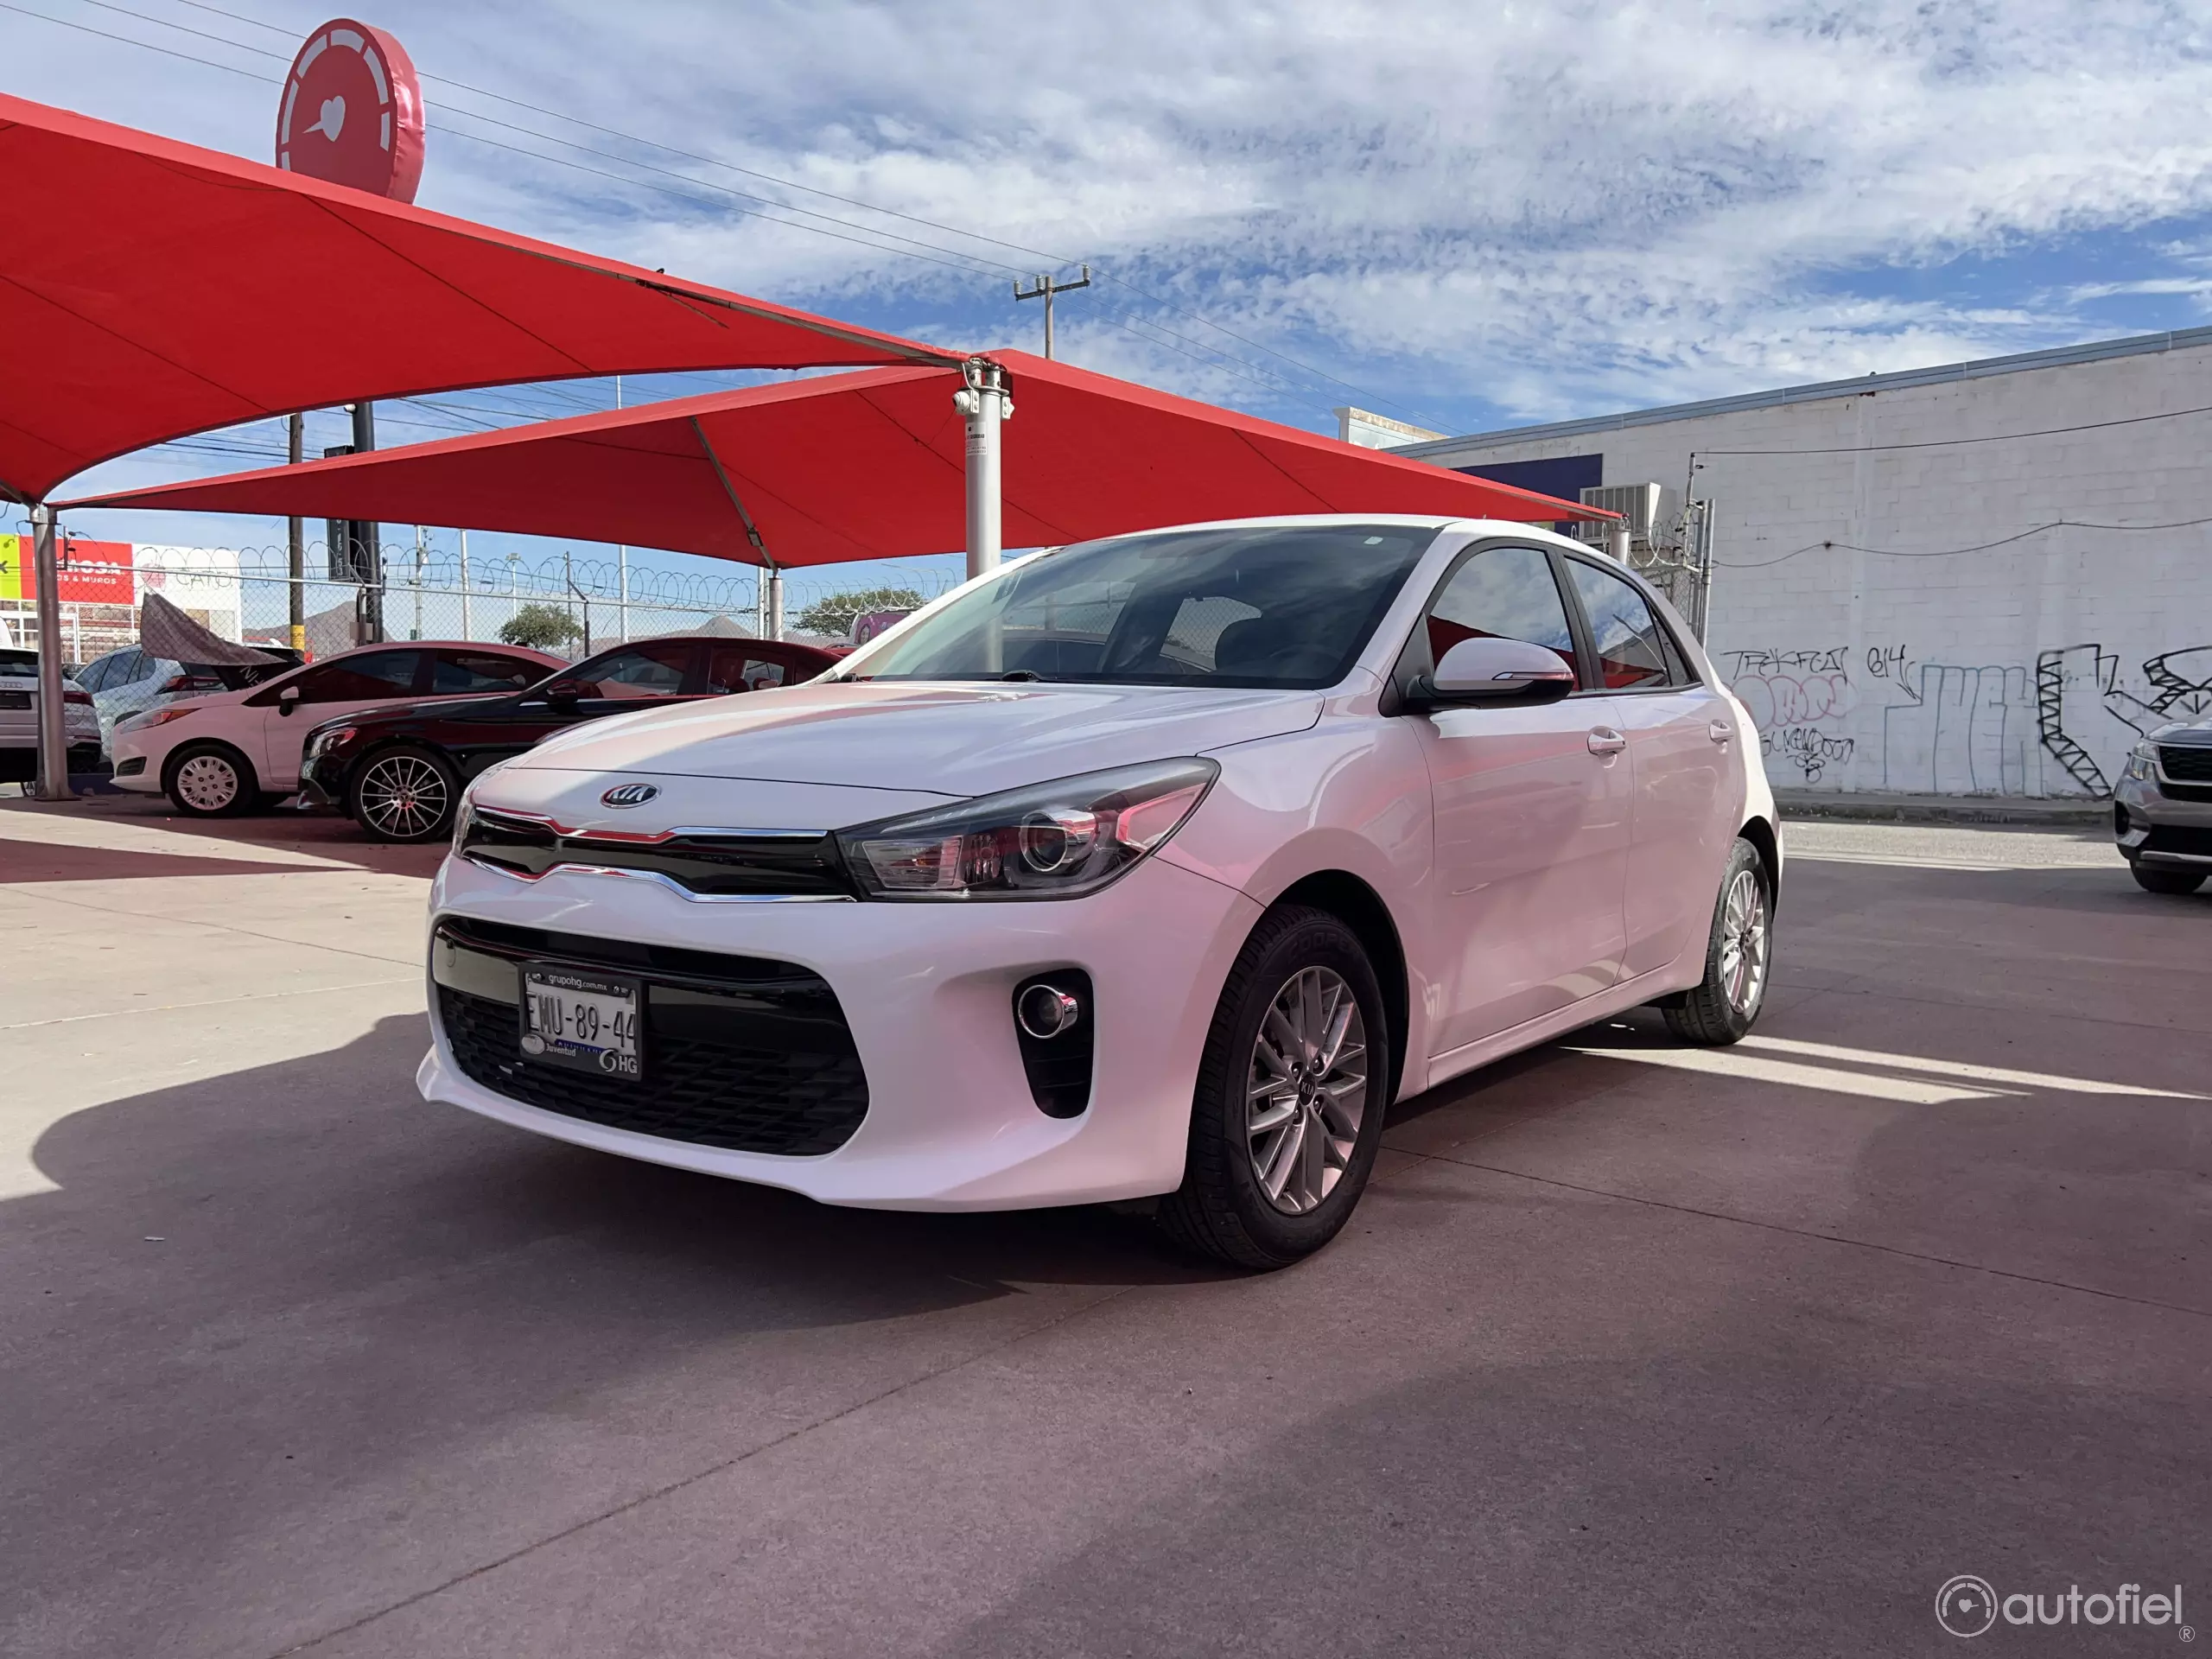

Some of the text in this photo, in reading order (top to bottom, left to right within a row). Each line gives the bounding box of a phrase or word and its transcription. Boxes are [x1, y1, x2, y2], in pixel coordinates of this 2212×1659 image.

[82, 575, 118, 585] MUROS
[548, 974, 608, 991] grupohg.com.mx
[618, 1054, 639, 1074] HG
[1300, 1082, 1314, 1096] KIA
